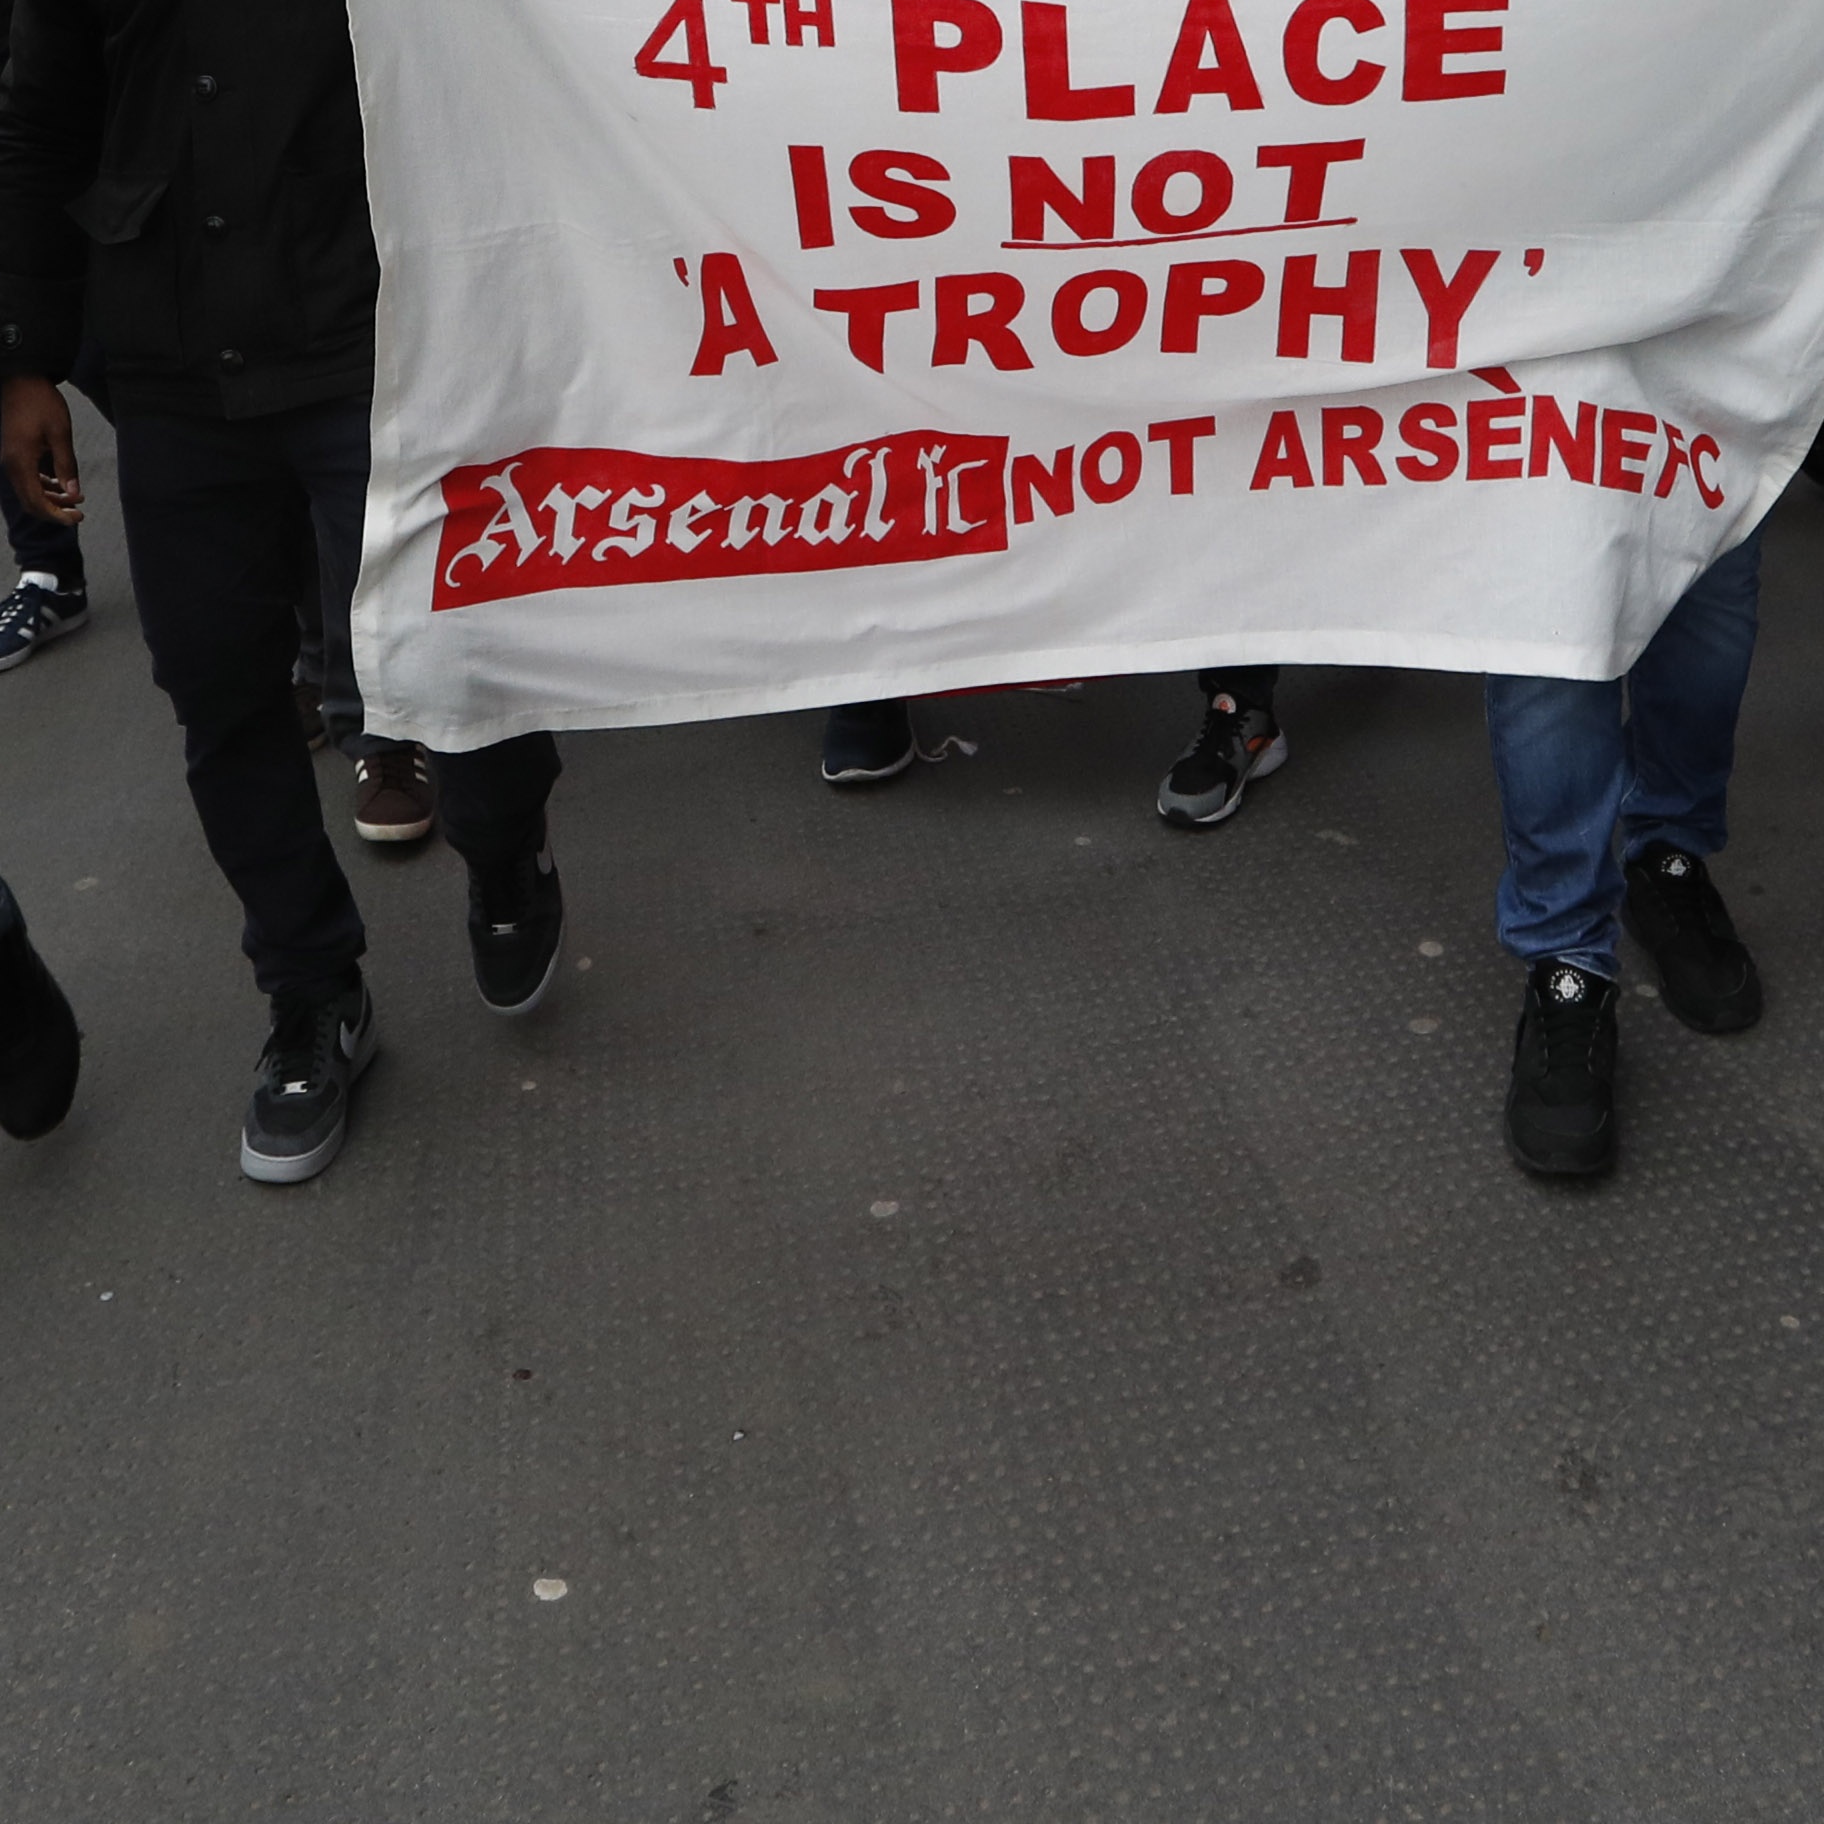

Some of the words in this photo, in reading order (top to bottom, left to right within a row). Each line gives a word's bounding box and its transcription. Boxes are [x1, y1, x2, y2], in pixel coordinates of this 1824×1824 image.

[788, 144, 957, 250] IS
[1007, 138, 1366, 242] NOT
[445, 447, 895, 588] Arsenal
[1011, 415, 1216, 526] NOT
